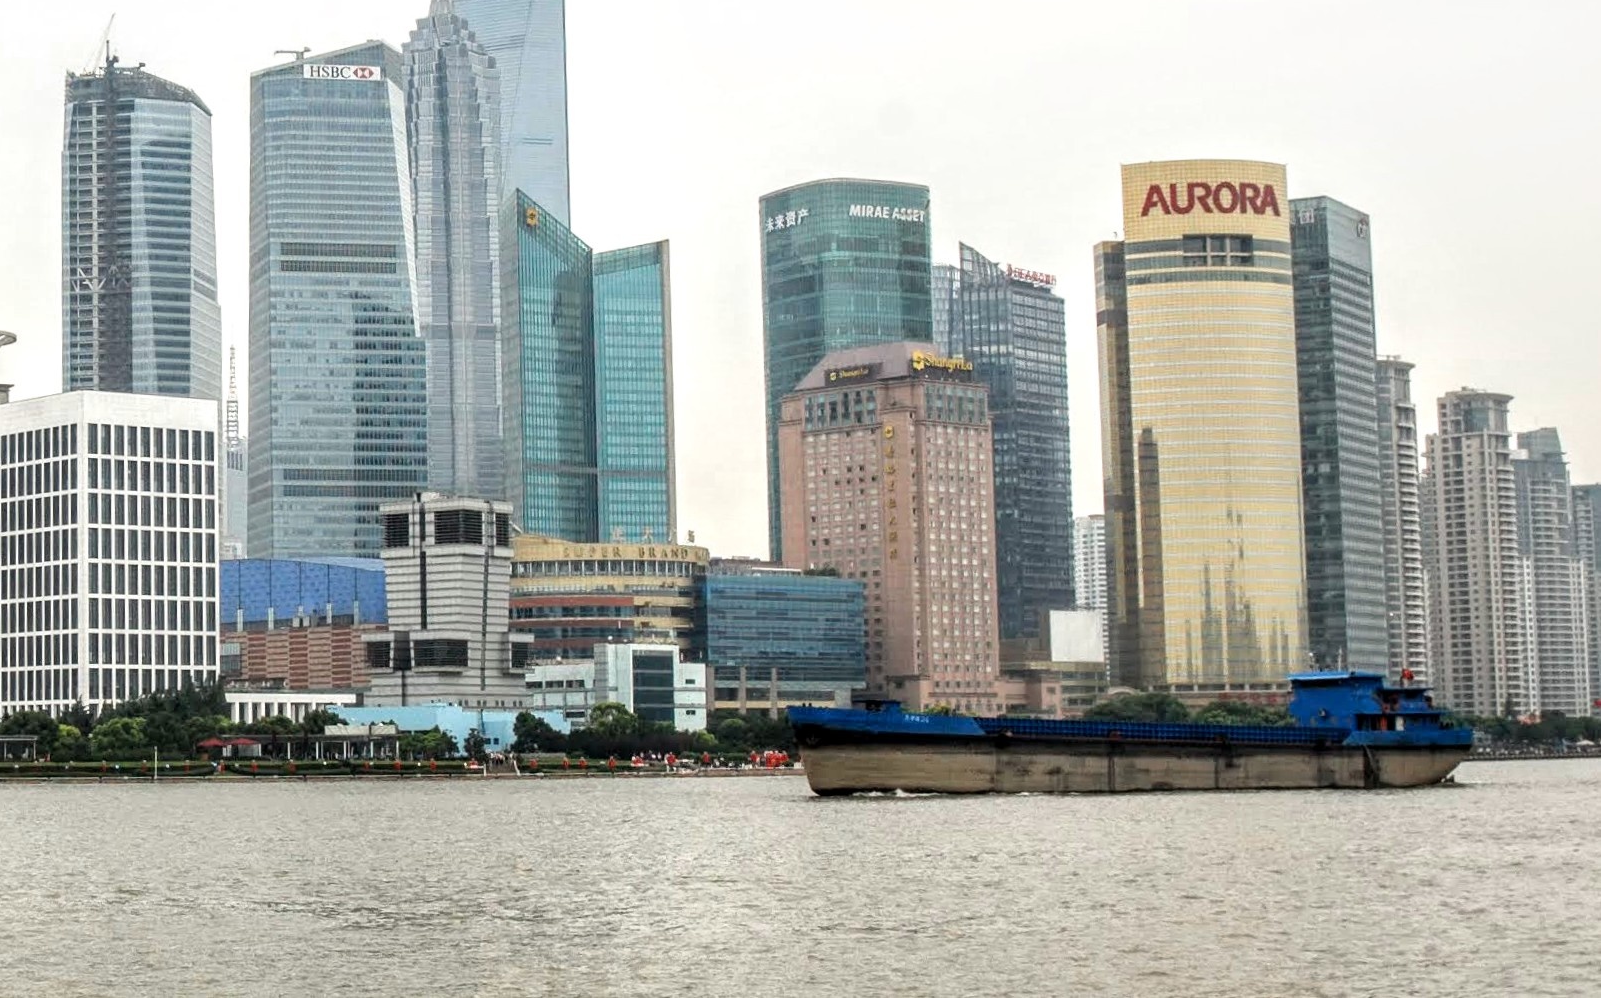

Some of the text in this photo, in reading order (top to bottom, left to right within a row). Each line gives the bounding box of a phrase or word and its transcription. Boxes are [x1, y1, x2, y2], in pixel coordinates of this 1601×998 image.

[309, 65, 351, 79] HSBC
[1141, 181, 1281, 217] AURORA
[849, 204, 926, 223] MIRAE ASSET
[638, 545, 689, 560] BRAND
